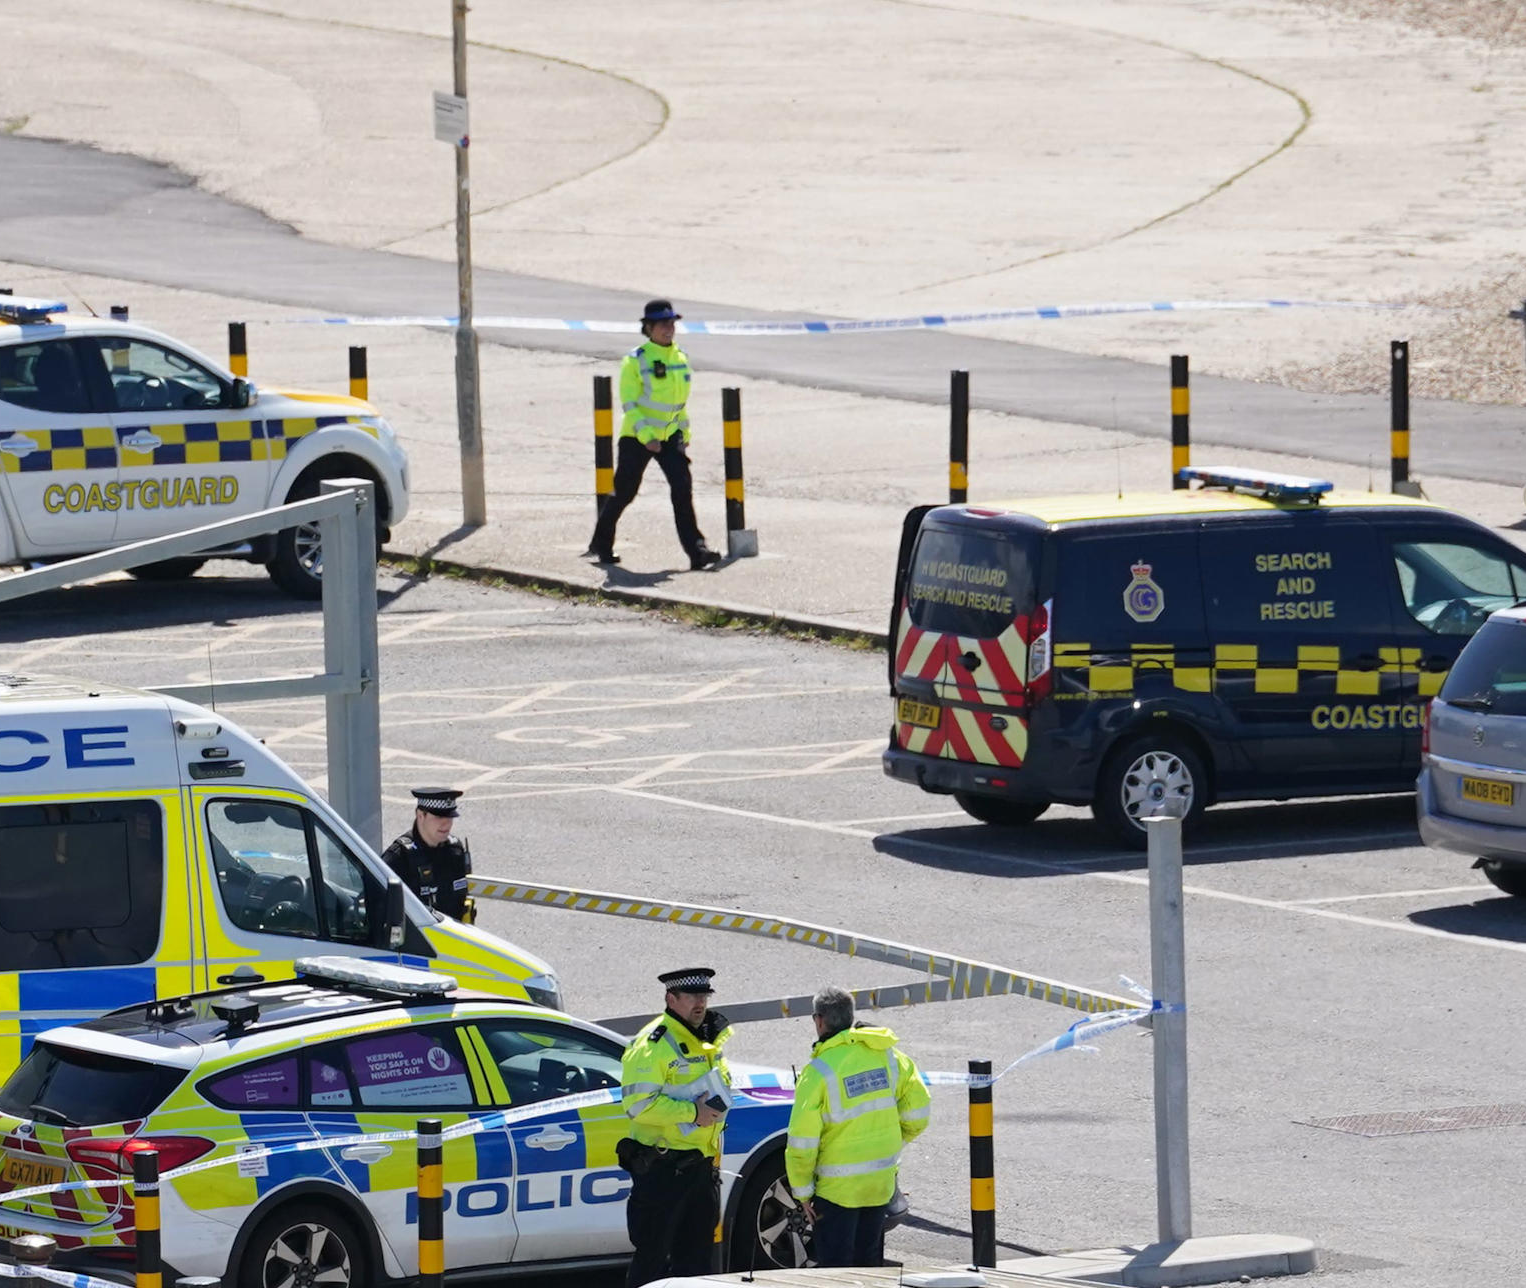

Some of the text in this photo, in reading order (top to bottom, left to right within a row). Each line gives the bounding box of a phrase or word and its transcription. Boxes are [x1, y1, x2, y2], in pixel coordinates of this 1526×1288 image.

[43, 475, 239, 514] COASTGUARD
[1255, 552, 1332, 573] SEARCH
[937, 562, 1008, 588] COASTGUARD
[1276, 577, 1316, 596] AND
[913, 583, 1014, 614] SEARCH AND RESCUE
[1260, 601, 1335, 621] RESCUE
[366, 1052, 404, 1063] KEEPING
[369, 1057, 424, 1071] YOU SAFE ON
[371, 1069, 403, 1080] NIGHTS
[9, 1162, 35, 1184] GX71
